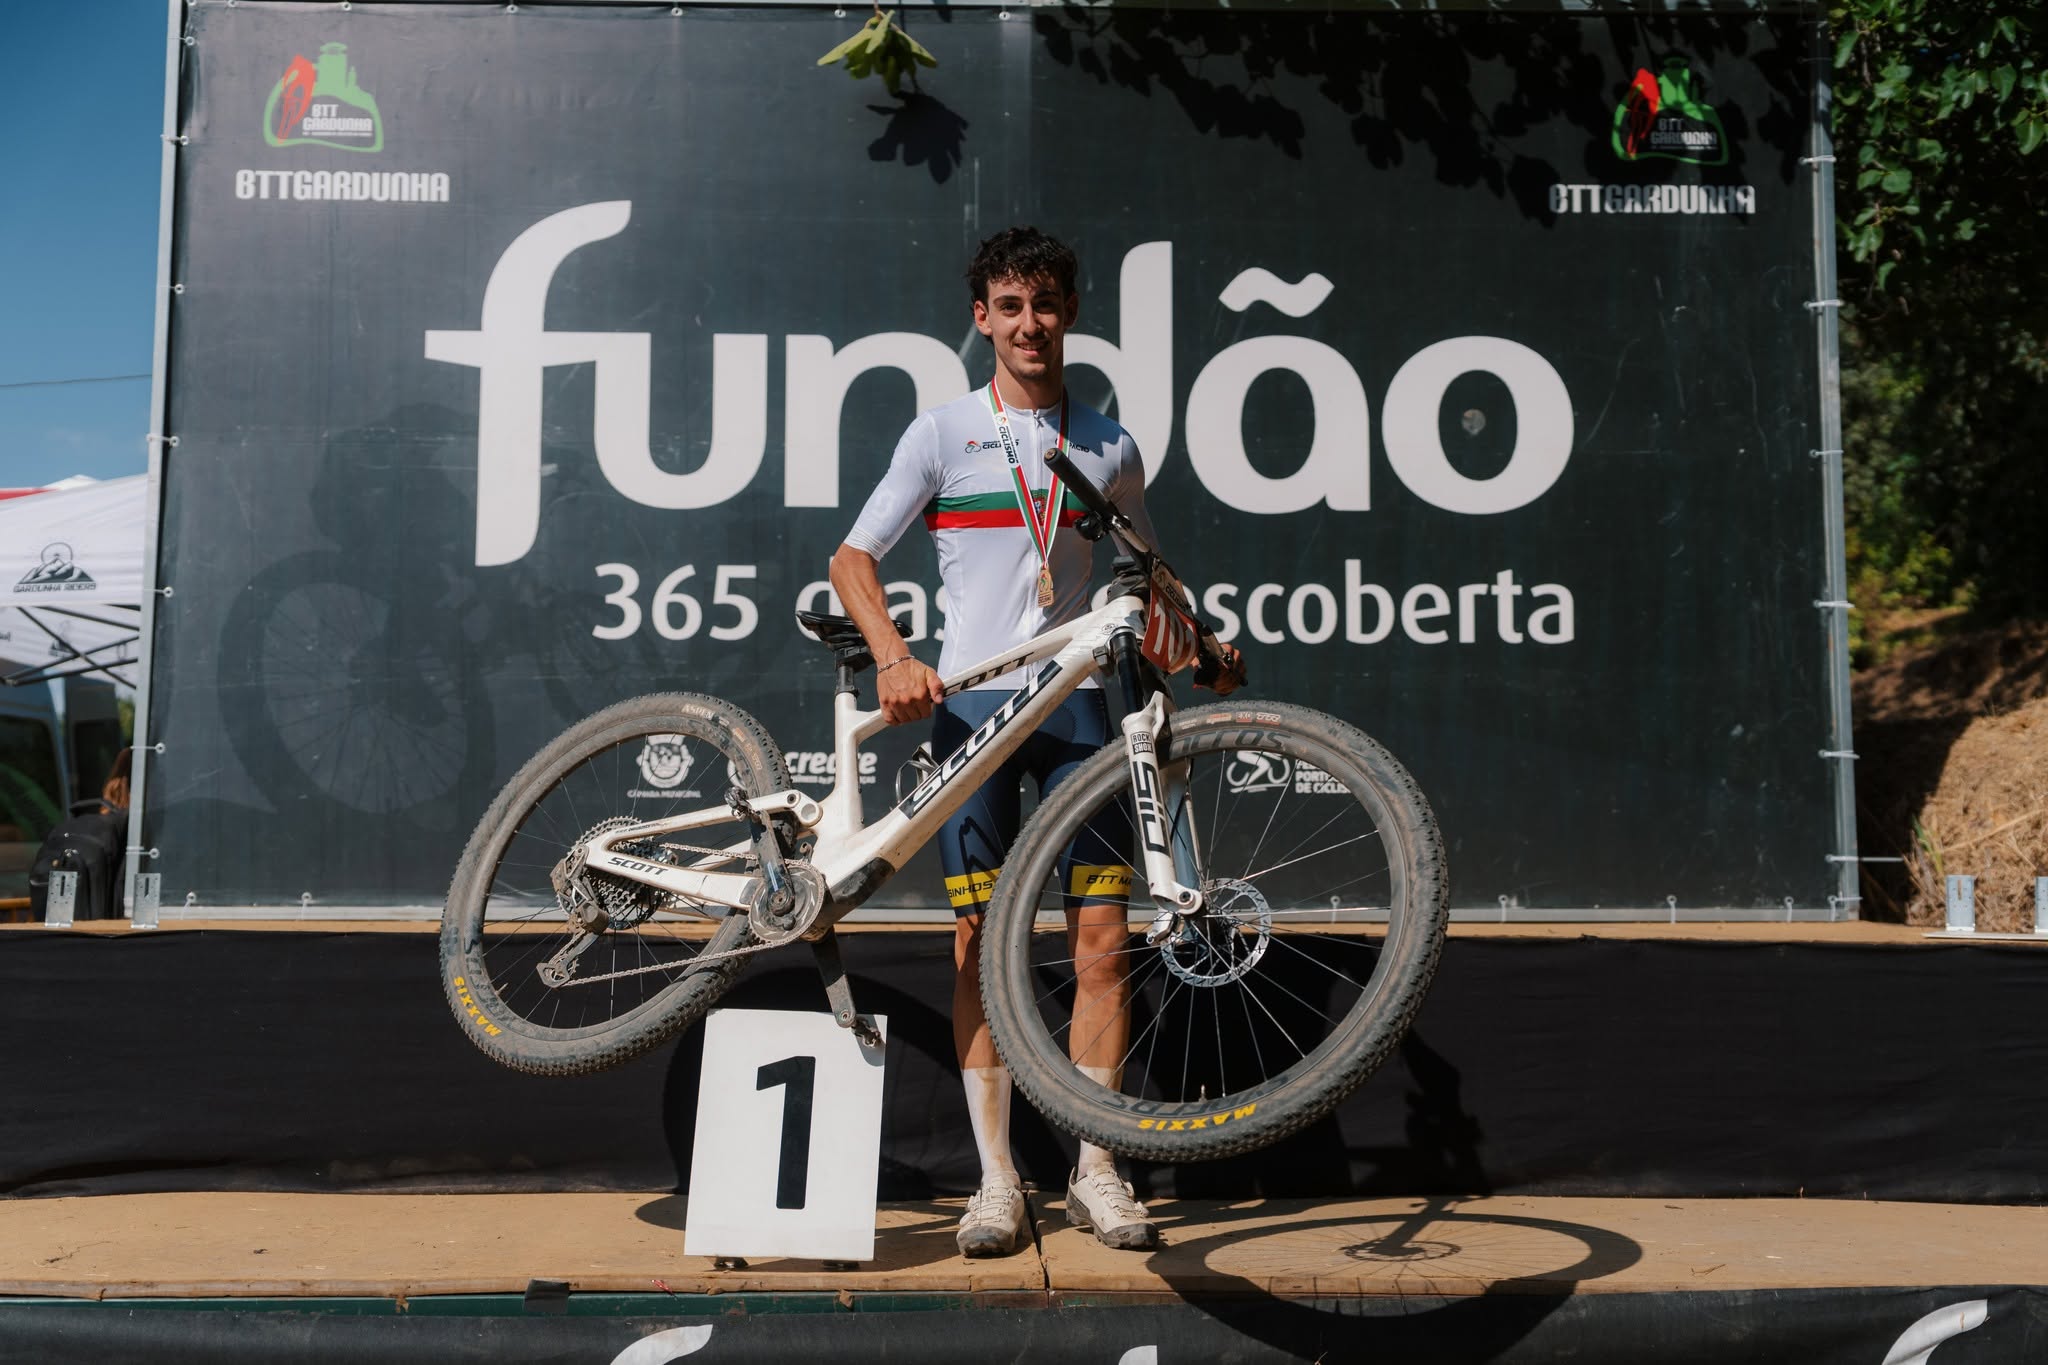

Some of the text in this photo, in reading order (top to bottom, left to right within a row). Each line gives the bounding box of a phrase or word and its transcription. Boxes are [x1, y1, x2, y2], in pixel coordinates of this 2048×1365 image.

[303, 117, 373, 132] GARDUNHA
[312, 104, 339, 117] BTT
[235, 169, 450, 202] BTTGARDUNHA
[1549, 183, 1756, 214] BTTGARDUNHA
[424, 200, 1575, 567] fundão
[999, 426, 1016, 464] CICLISMO
[592, 562, 760, 641] 365
[912, 660, 1053, 812] SCOTT
[1132, 734, 1151, 744] ROCK
[608, 857, 669, 876] SCOTT
[1086, 874, 1118, 885] BTT
[454, 976, 502, 1037] MAXXIS
[756, 1056, 817, 1210] 1
[1137, 1103, 1257, 1131] MAXXIS
